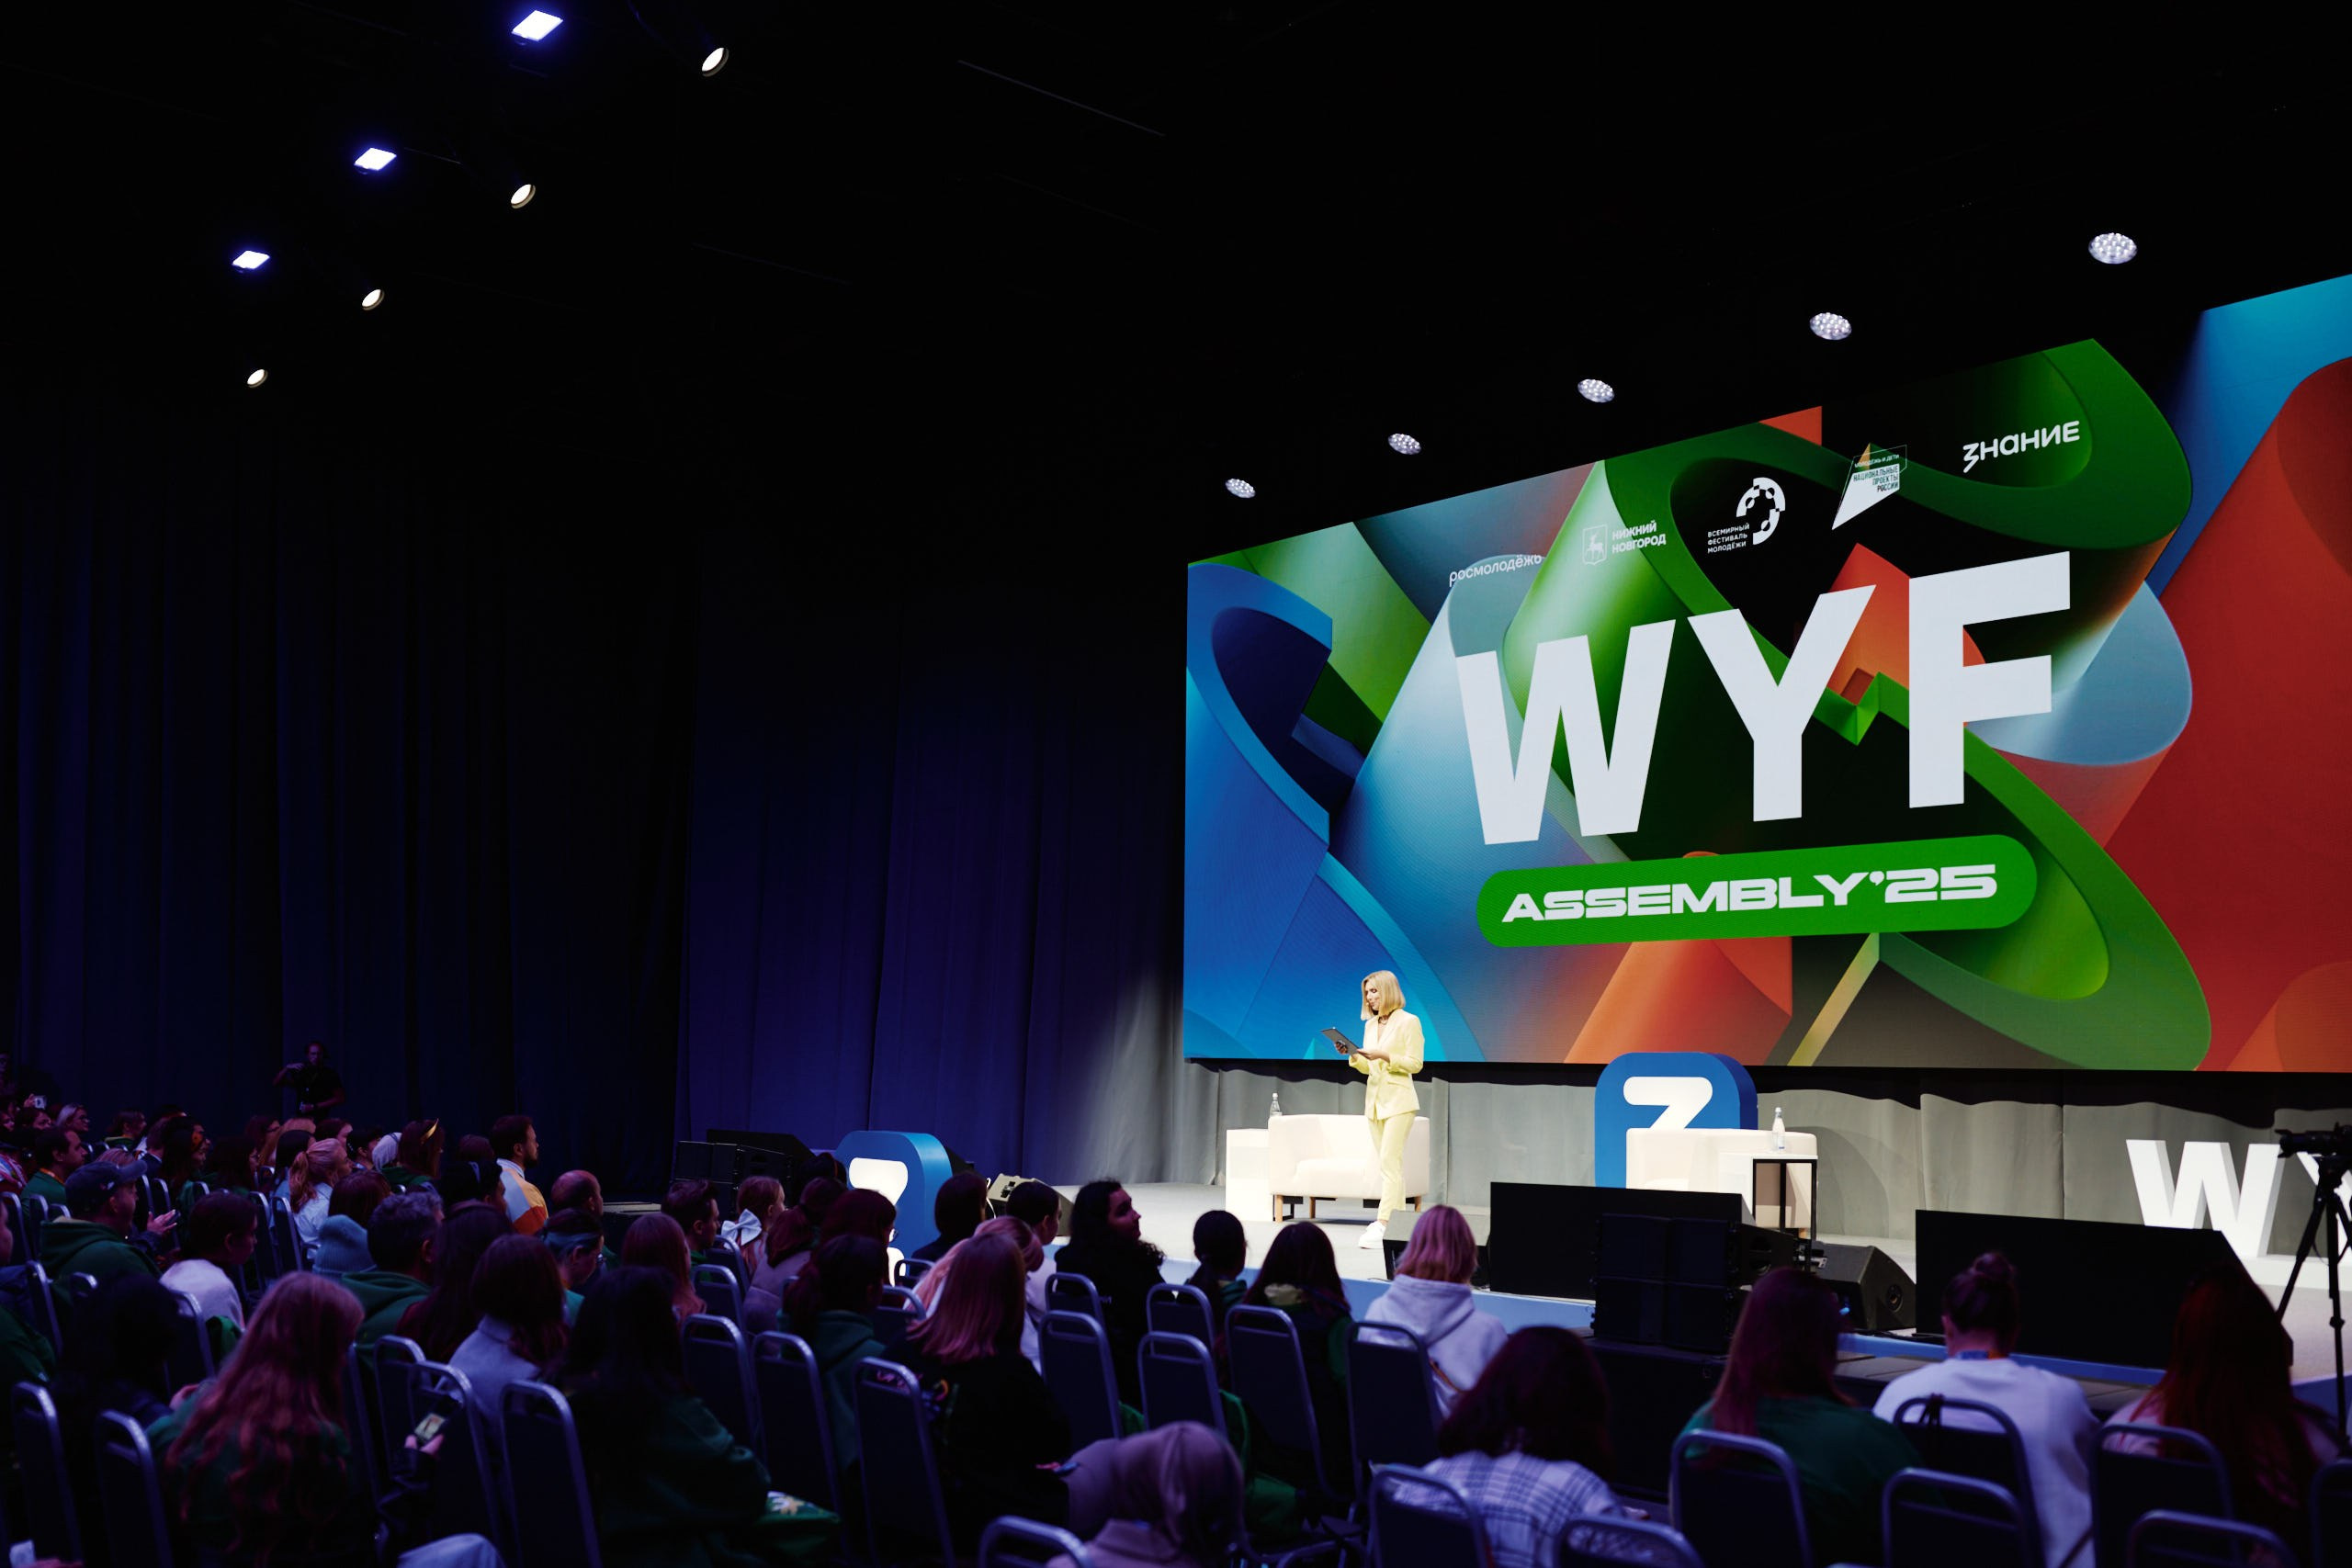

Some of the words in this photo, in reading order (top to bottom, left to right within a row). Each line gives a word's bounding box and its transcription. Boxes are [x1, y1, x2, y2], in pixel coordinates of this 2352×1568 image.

[1853, 466, 1899, 481] НАЦИОНАЛЬНЫЕ
[1872, 474, 1899, 485] ПРОЕКТЫ
[1877, 482, 1899, 492] РОССИИ
[1612, 520, 1657, 541] НИЖНИЙ
[1708, 523, 1750, 538] ВСЕМИРНЫЙ
[1612, 534, 1667, 554] НОВГОРОД
[1708, 533, 1748, 546] ФЕСТИВАЛЬ
[1449, 555, 1543, 588] росмолодёжь
[1456, 552, 2070, 845] WYF
